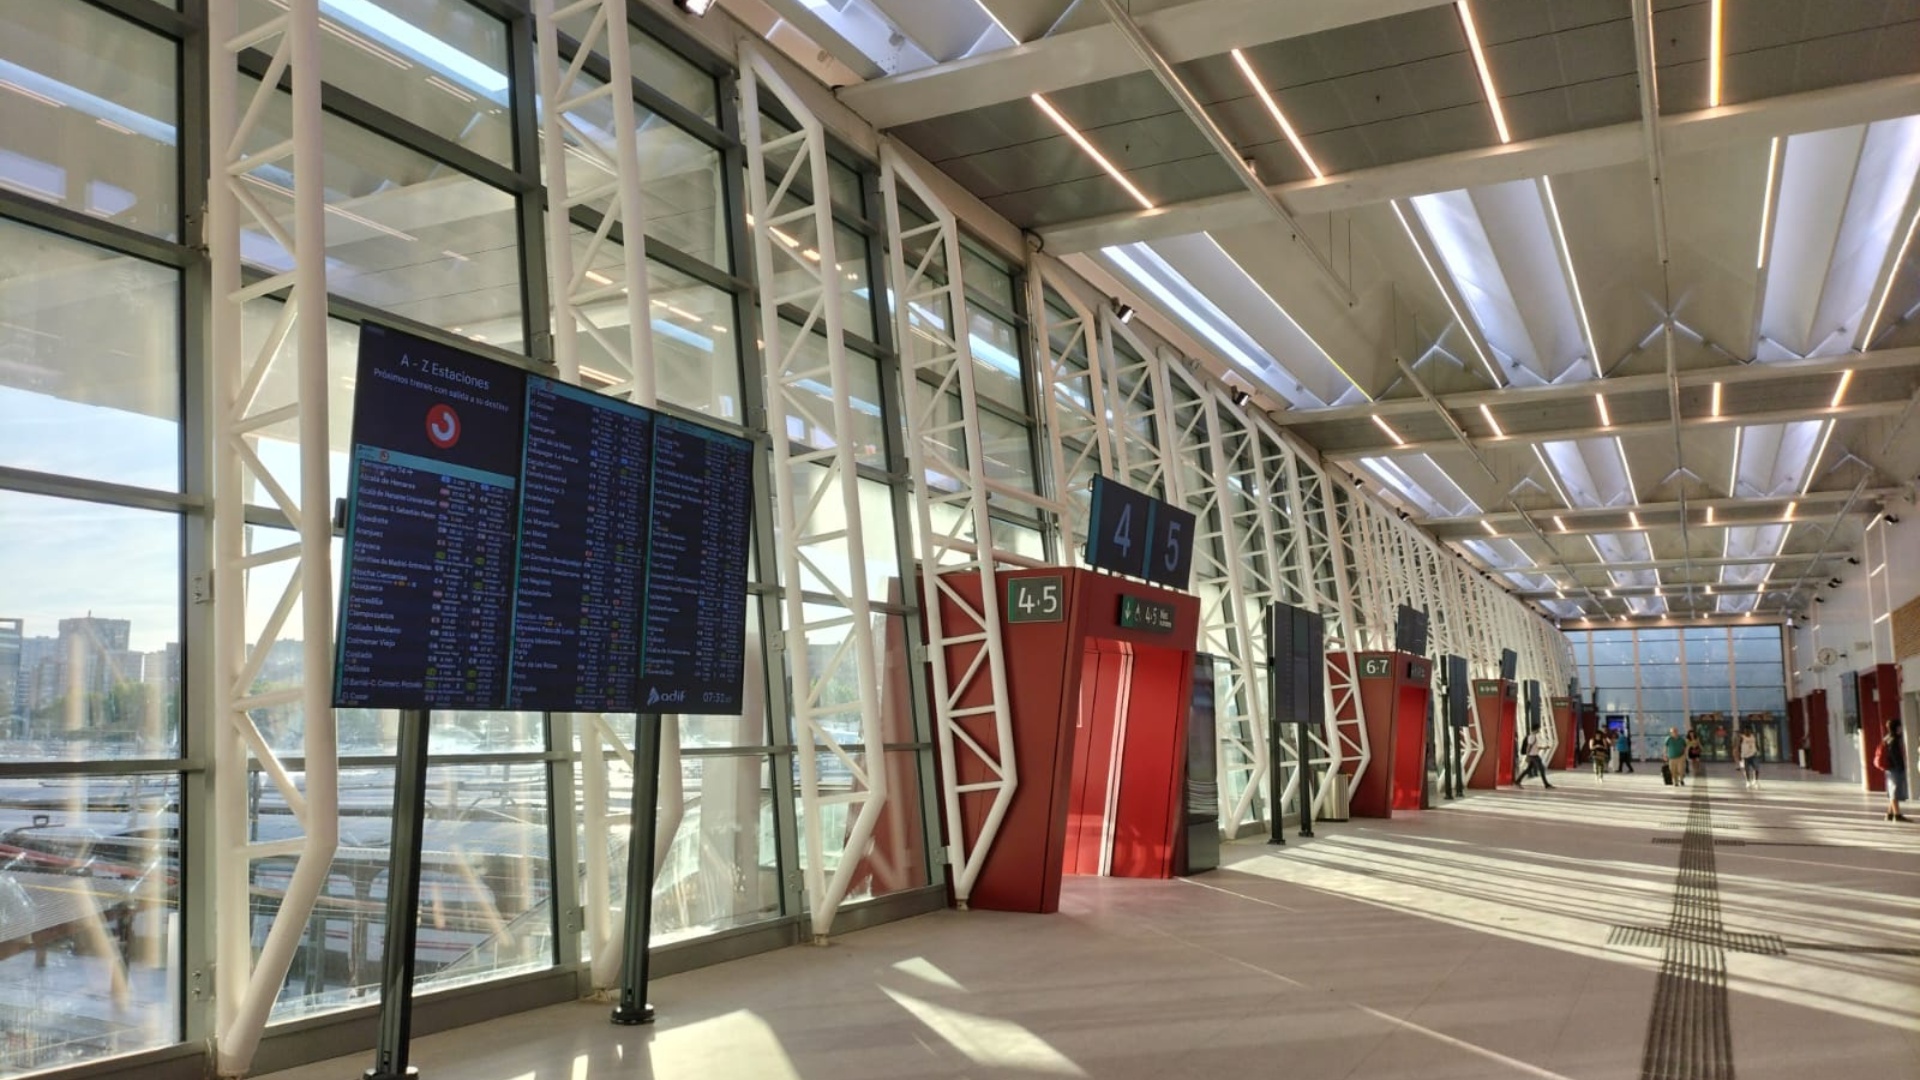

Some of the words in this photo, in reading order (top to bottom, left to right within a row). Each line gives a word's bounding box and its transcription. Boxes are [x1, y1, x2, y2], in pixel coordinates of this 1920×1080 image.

[400, 353, 409, 367] A
[422, 360, 429, 372] Z
[432, 363, 490, 390] Estaciones
[1113, 503, 1131, 558] 4
[1164, 521, 1181, 571] 5
[661, 690, 686, 702] adif
